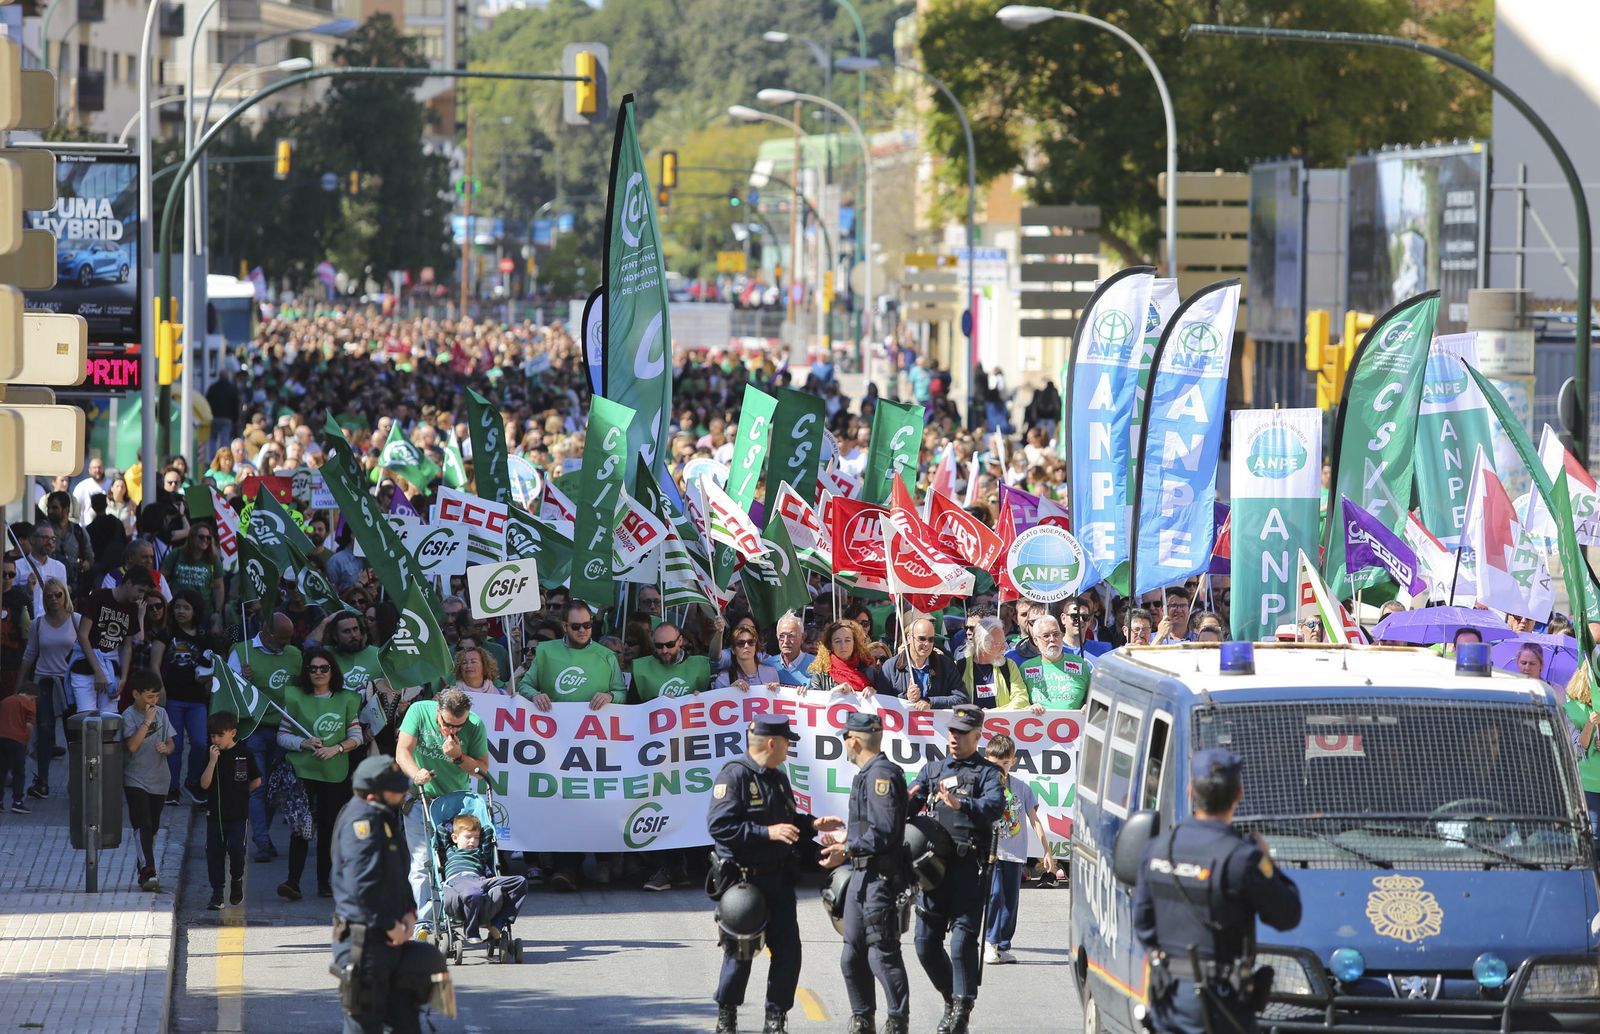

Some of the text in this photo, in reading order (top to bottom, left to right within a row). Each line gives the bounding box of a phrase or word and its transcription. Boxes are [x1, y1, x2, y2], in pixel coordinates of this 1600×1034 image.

[43, 197, 114, 219] UMA
[78, 303, 102, 315] Ford
[1086, 342, 1132, 360] ANPE
[1171, 352, 1224, 370] ANPE
[1423, 382, 1461, 398] ANPE
[738, 416, 765, 497] CSI
[787, 413, 816, 490] CSI
[1253, 456, 1299, 470] ANPE
[440, 498, 509, 534] CCO
[250, 517, 282, 546] CSIF
[507, 528, 542, 556] CSIF
[1011, 528, 1082, 556] SINDICATO INDEPENDIENTE
[1021, 567, 1070, 581] ANPE
[1260, 507, 1290, 643] ANP
[1025, 589, 1069, 602] ANDALUCÍA
[347, 672, 371, 683] CSIF
[561, 674, 588, 686] CSIF
[667, 685, 690, 697] CSIF
[318, 719, 343, 731] CSIF
[494, 707, 558, 739] NO
[574, 714, 635, 742] AL
[649, 697, 858, 735] DECRETO
[877, 707, 935, 736] DE
[981, 717, 1080, 744] SCO
[487, 738, 546, 766] NO
[560, 746, 621, 772] AL
[469, 770, 509, 797] N
[528, 767, 713, 800] DEFENS
[632, 815, 670, 834] CSIF
